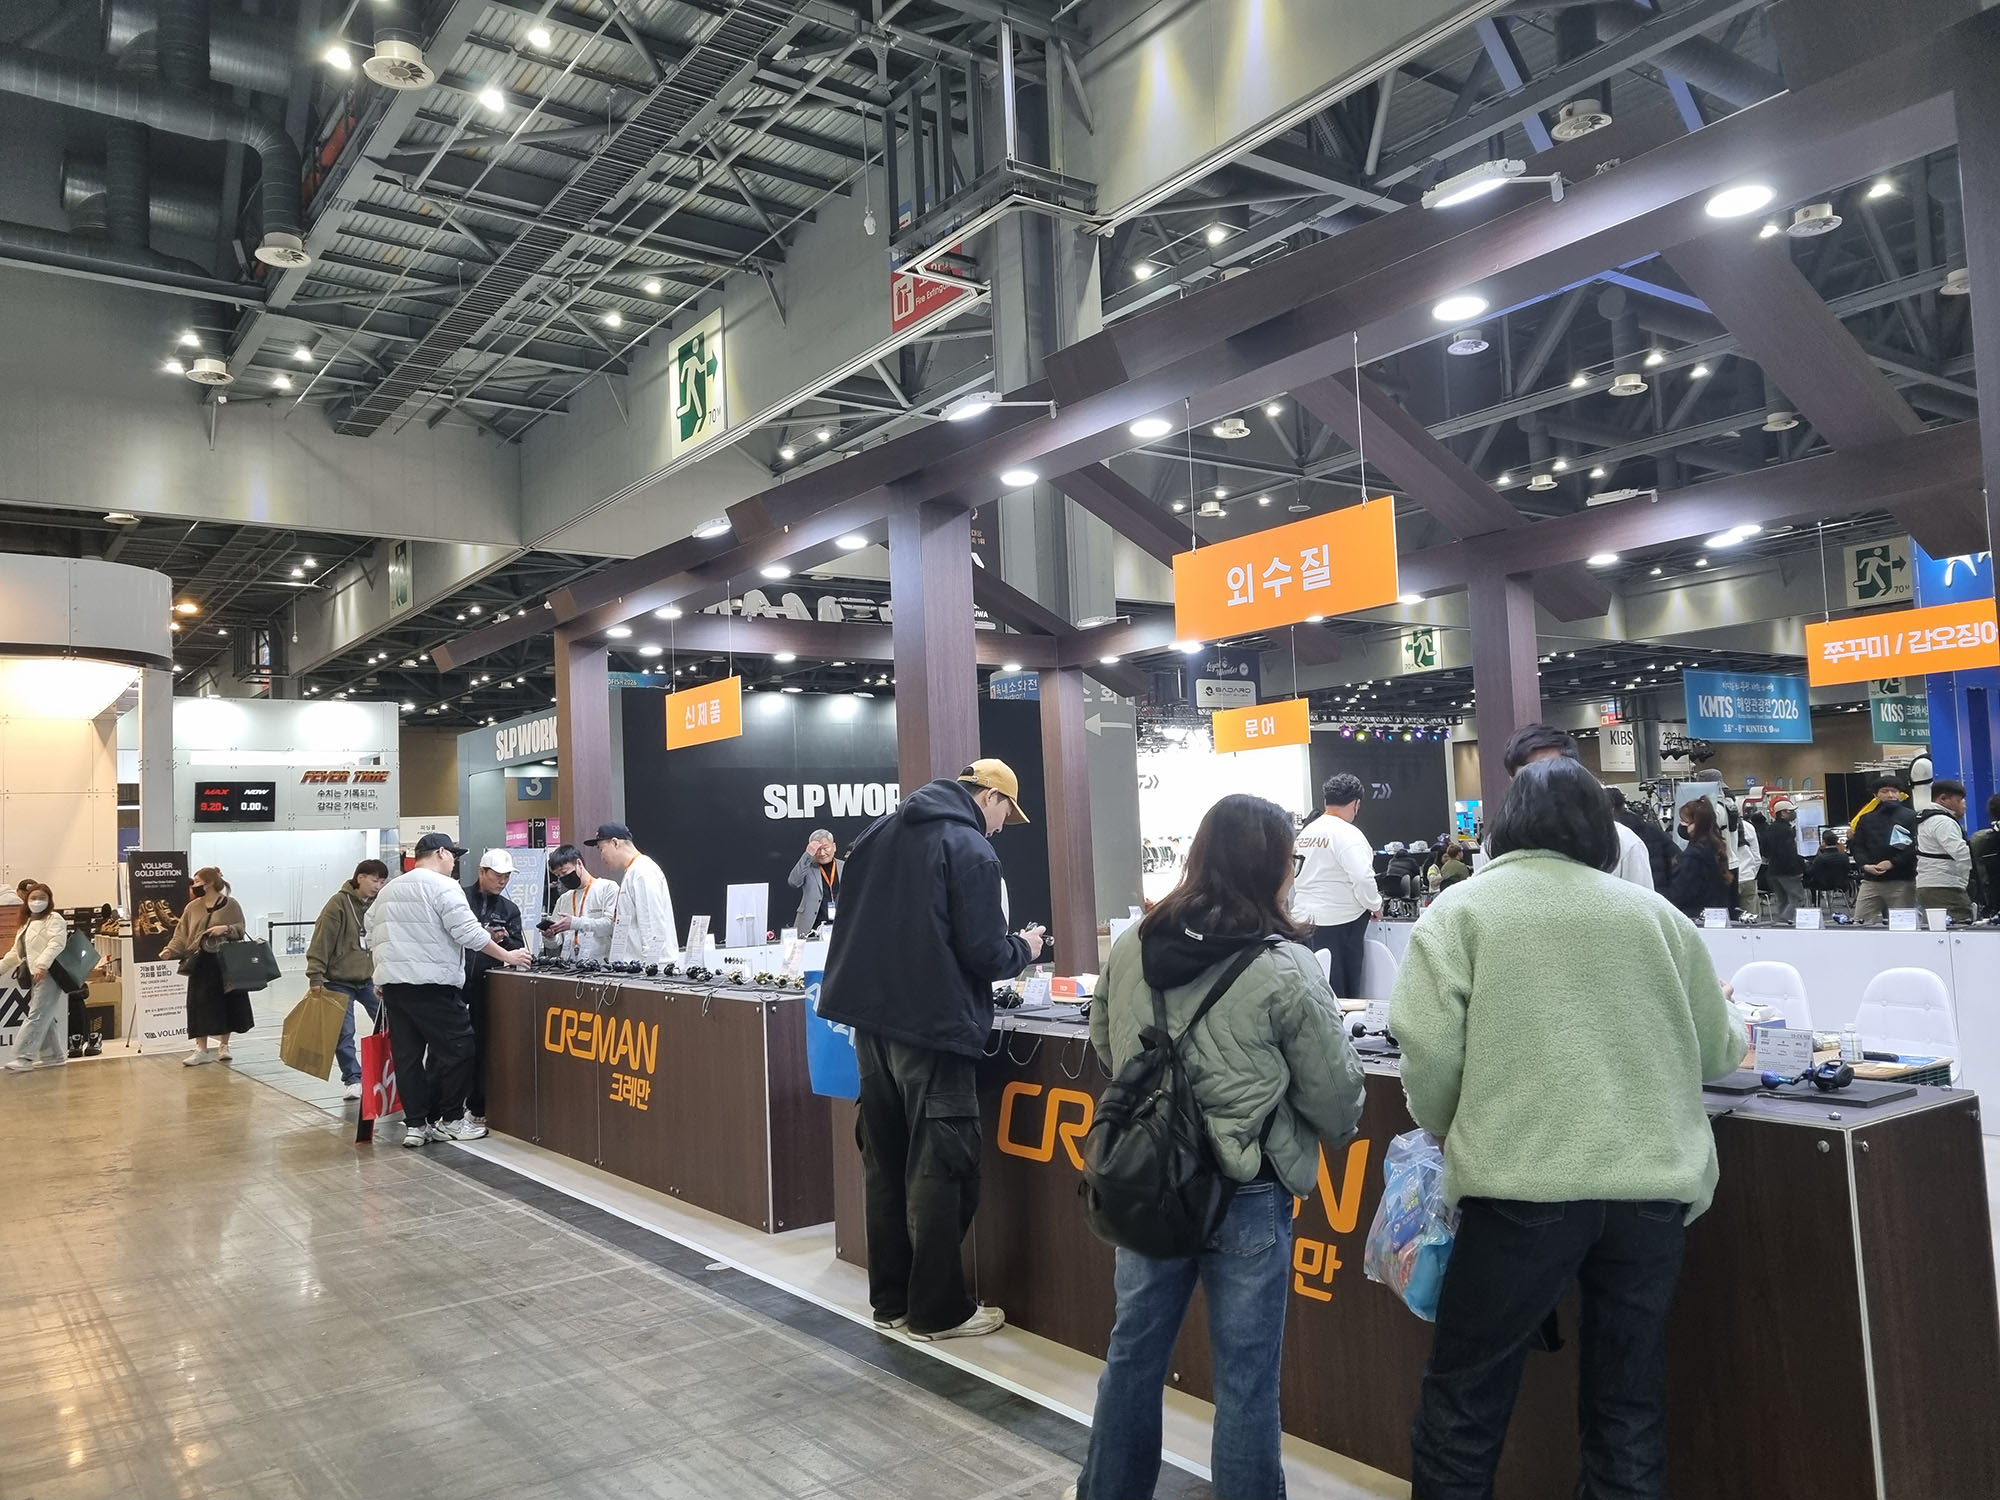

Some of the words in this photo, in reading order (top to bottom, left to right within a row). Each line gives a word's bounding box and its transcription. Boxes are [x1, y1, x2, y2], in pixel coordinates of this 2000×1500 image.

[1226, 544, 1332, 607] 외수질
[1824, 634, 1891, 664] 쭈꾸미
[685, 699, 721, 730] 신제품
[1698, 695, 1734, 718] KMTS
[1771, 699, 1799, 719] 2026
[1880, 703, 1904, 722] KISS
[1245, 716, 1275, 738] 문어
[495, 727, 518, 762] SLP
[1609, 730, 1633, 746] KIBS
[300, 770, 350, 785] FEVER
[352, 770, 391, 784] TIME
[525, 777, 543, 797] 3
[204, 788, 231, 796] MAX
[244, 788, 270, 796] NOW
[317, 788, 342, 799] 수치는
[343, 788, 379, 800] 기록되고,
[763, 783, 826, 820] SLP
[200, 802, 222, 812] 9.20
[240, 802, 262, 812] 0.00
[317, 801, 342, 812] 감각은
[343, 801, 378, 812] 기억된다.
[141, 862, 173, 870] VOLLMER
[155, 869, 182, 877] EDITION
[545, 1007, 659, 1074] CREMAN
[609, 1072, 651, 1111] 크레만
